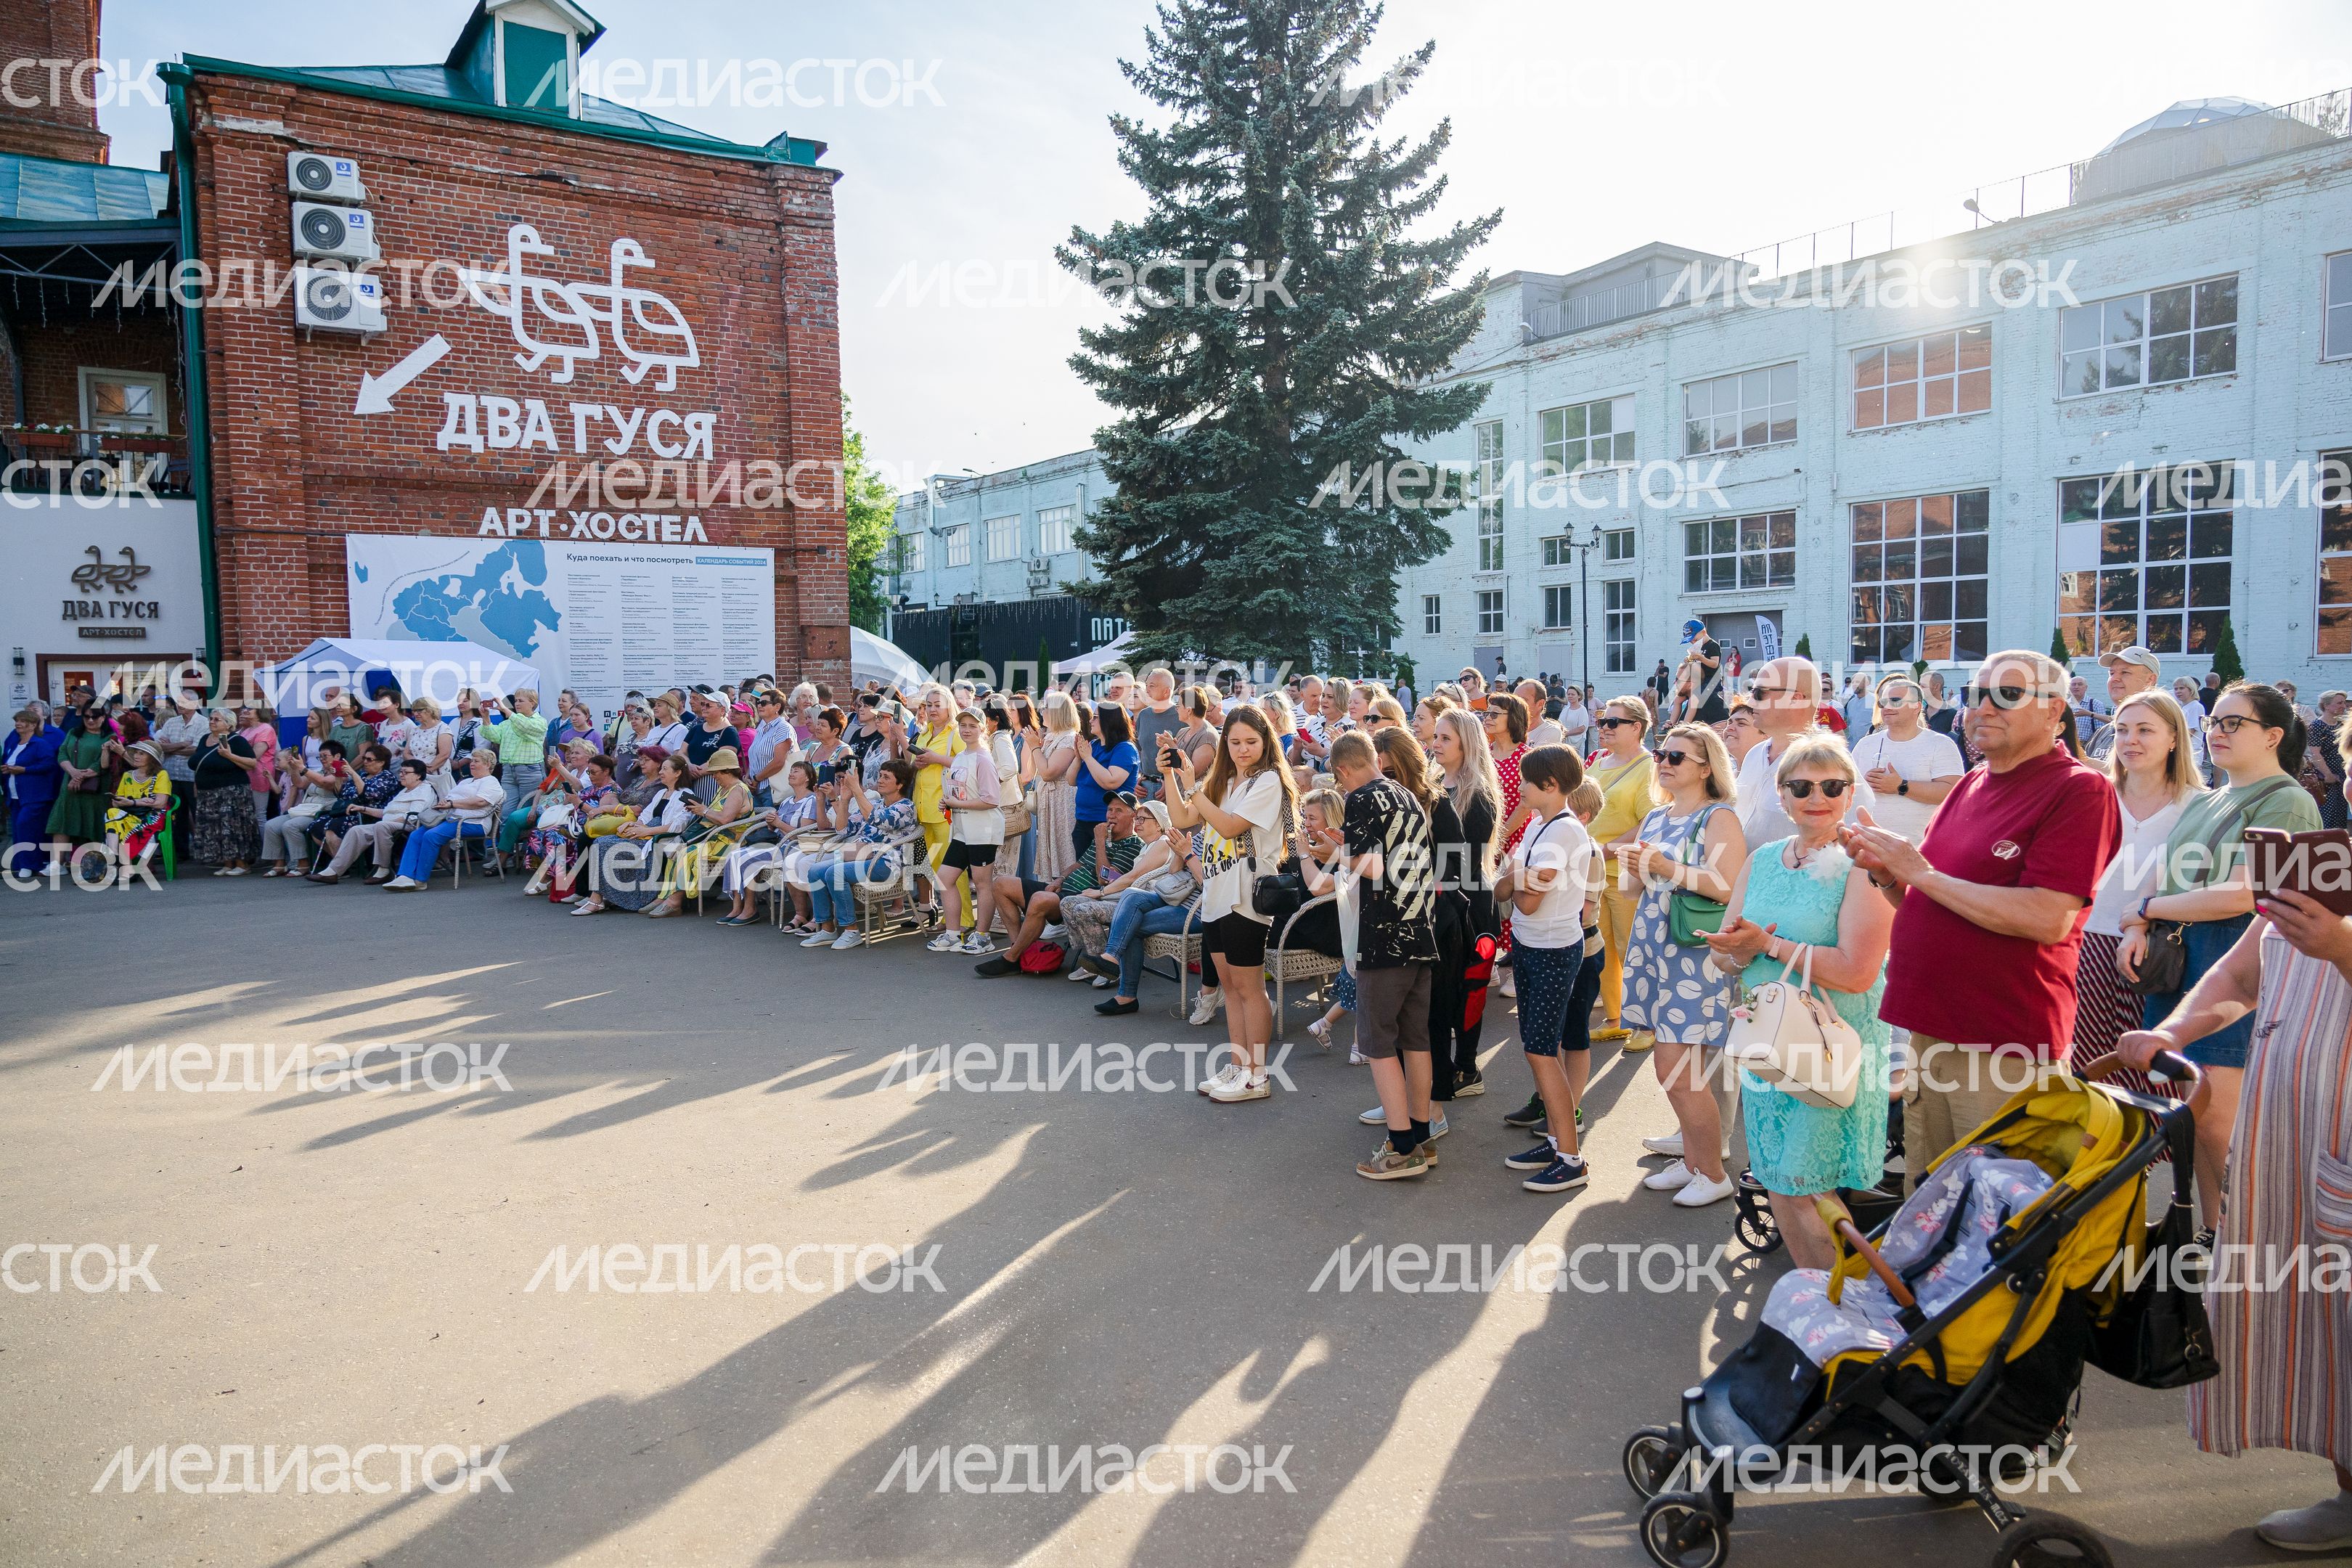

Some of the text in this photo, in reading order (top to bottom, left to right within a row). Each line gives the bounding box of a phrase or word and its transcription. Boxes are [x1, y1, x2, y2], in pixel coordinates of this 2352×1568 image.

[436, 392, 717, 461] ДВА ГУСЯ
[567, 553, 587, 562] Куда
[62, 600, 159, 620] ДВА ГУСЯ
